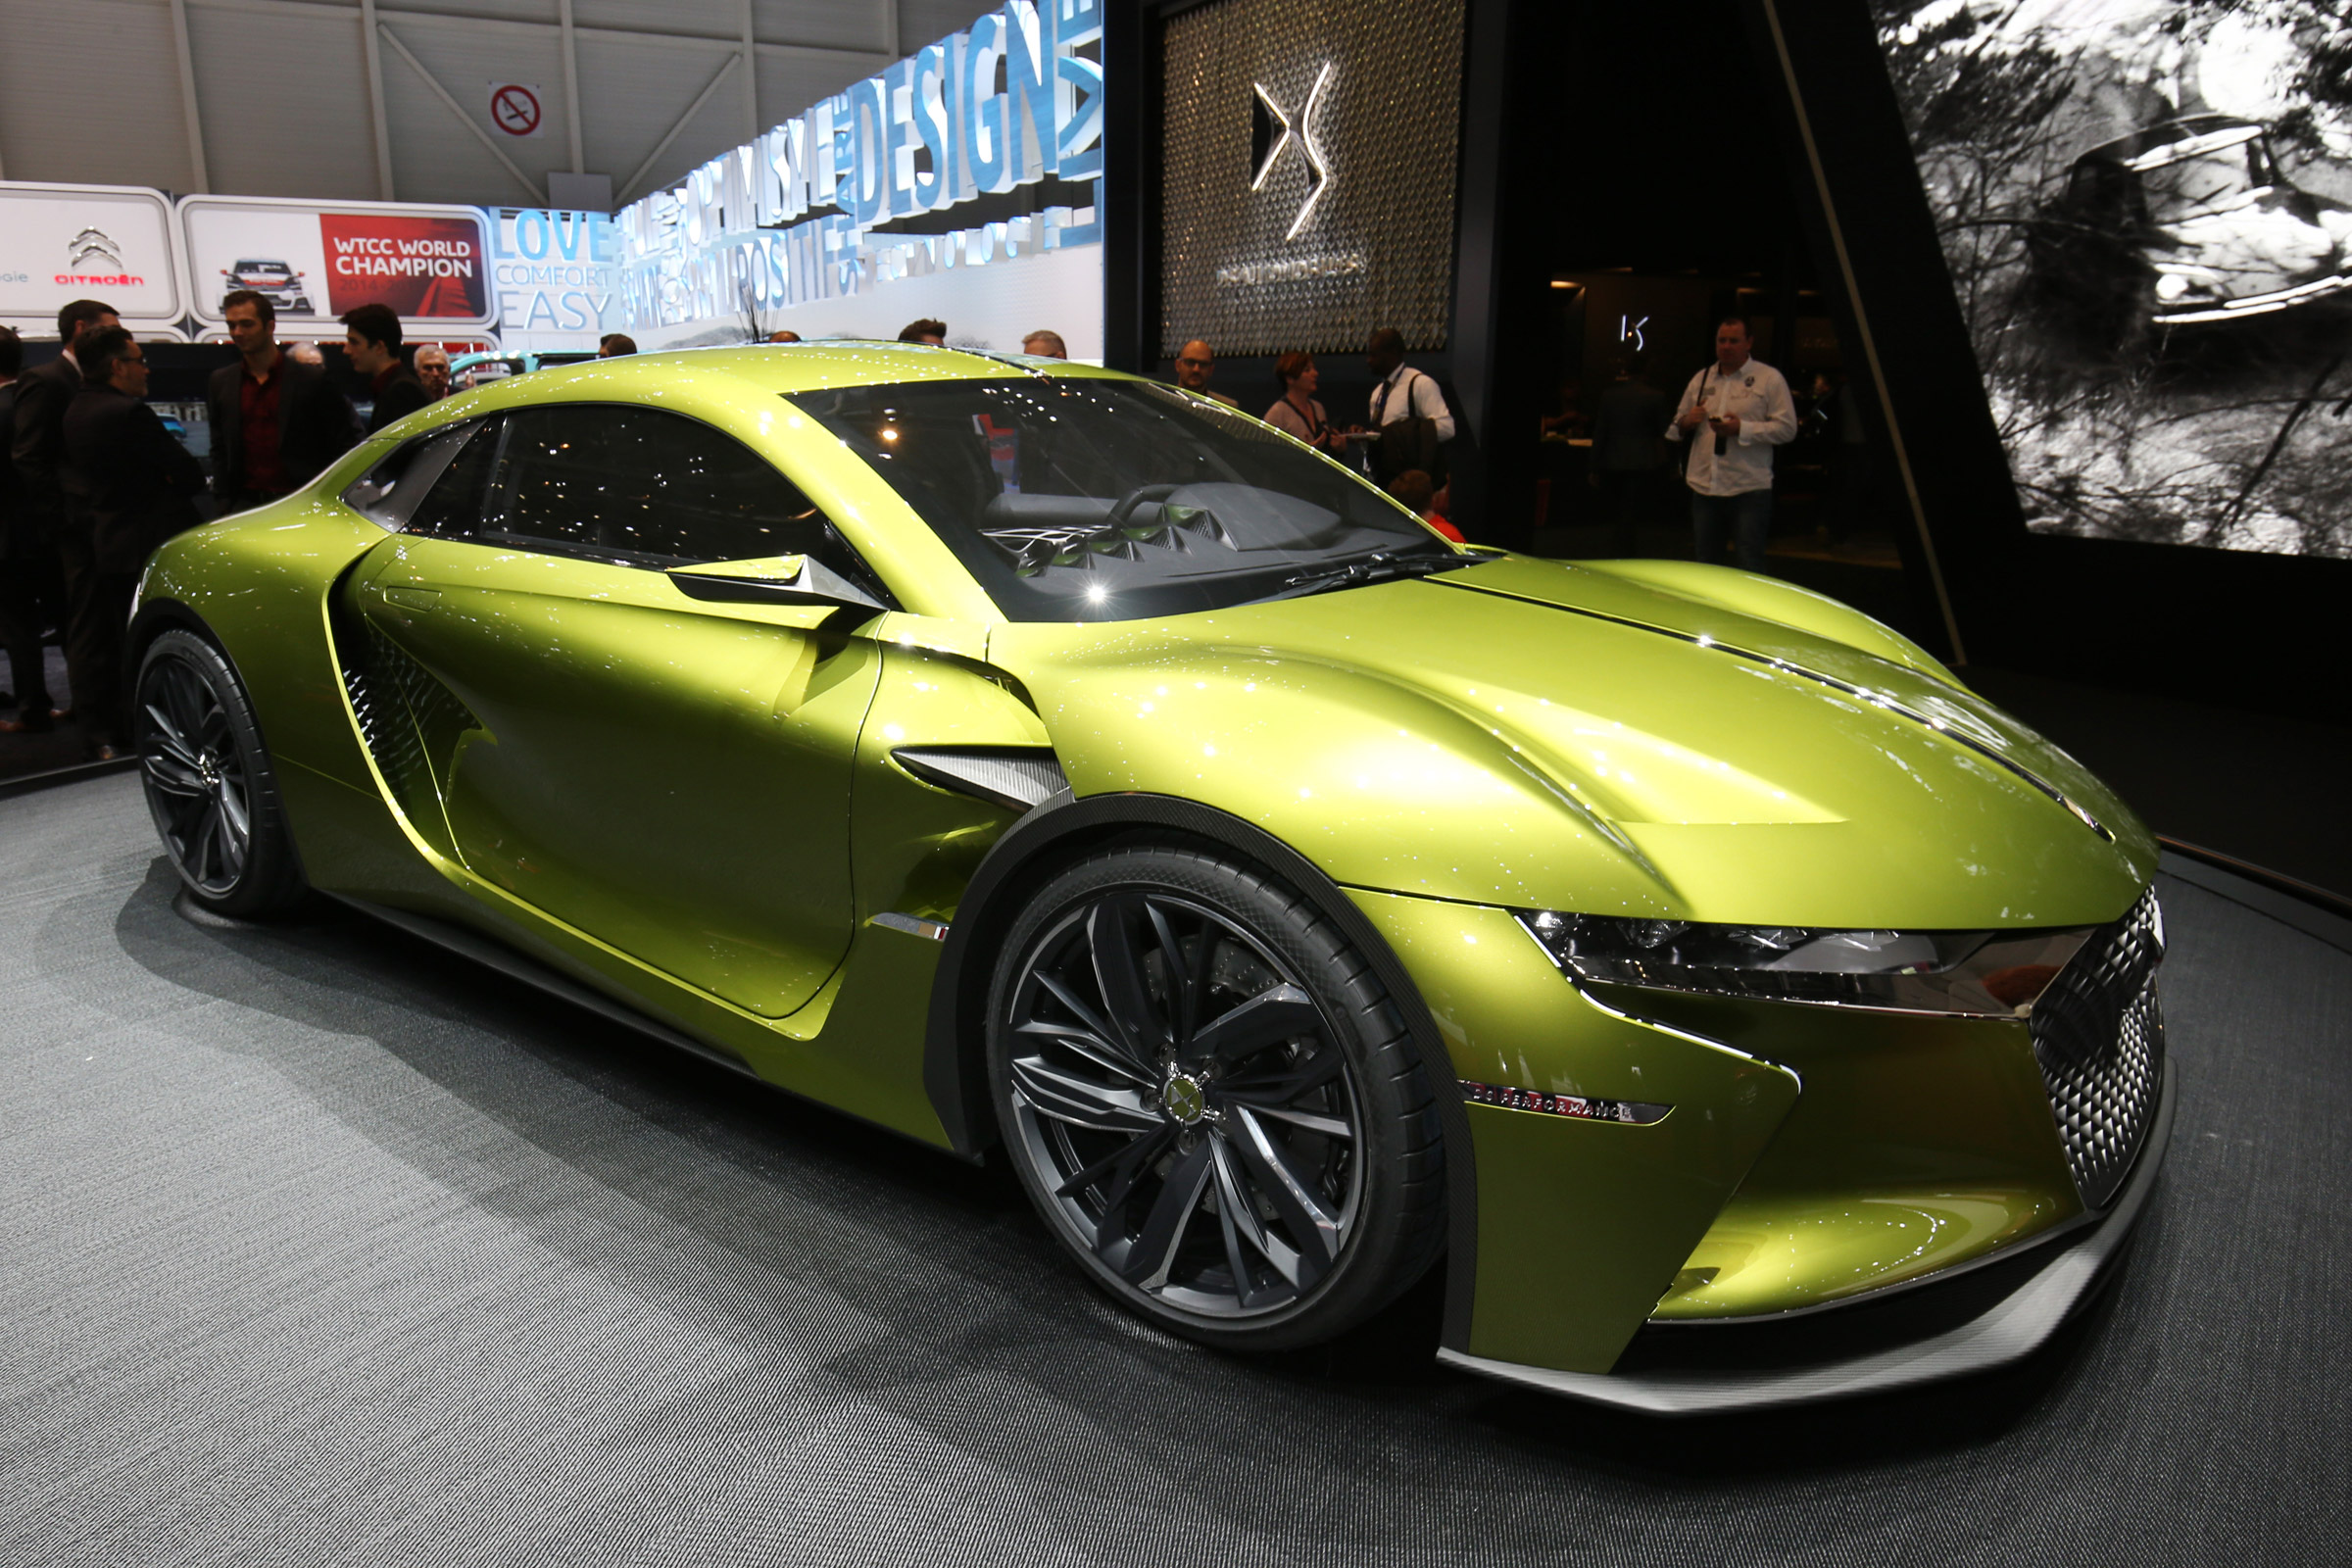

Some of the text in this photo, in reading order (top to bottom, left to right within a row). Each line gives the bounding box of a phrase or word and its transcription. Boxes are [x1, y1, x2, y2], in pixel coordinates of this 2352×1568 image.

[846, 0, 1058, 226] DESIGN
[333, 237, 470, 257] WTCC WORLD
[489, 206, 613, 263] LOVE
[335, 256, 472, 277] CHAMPION
[496, 265, 612, 288] COMFORT
[497, 289, 612, 330] EASY
[1499, 1093, 1632, 1119] PERFORMANCE
